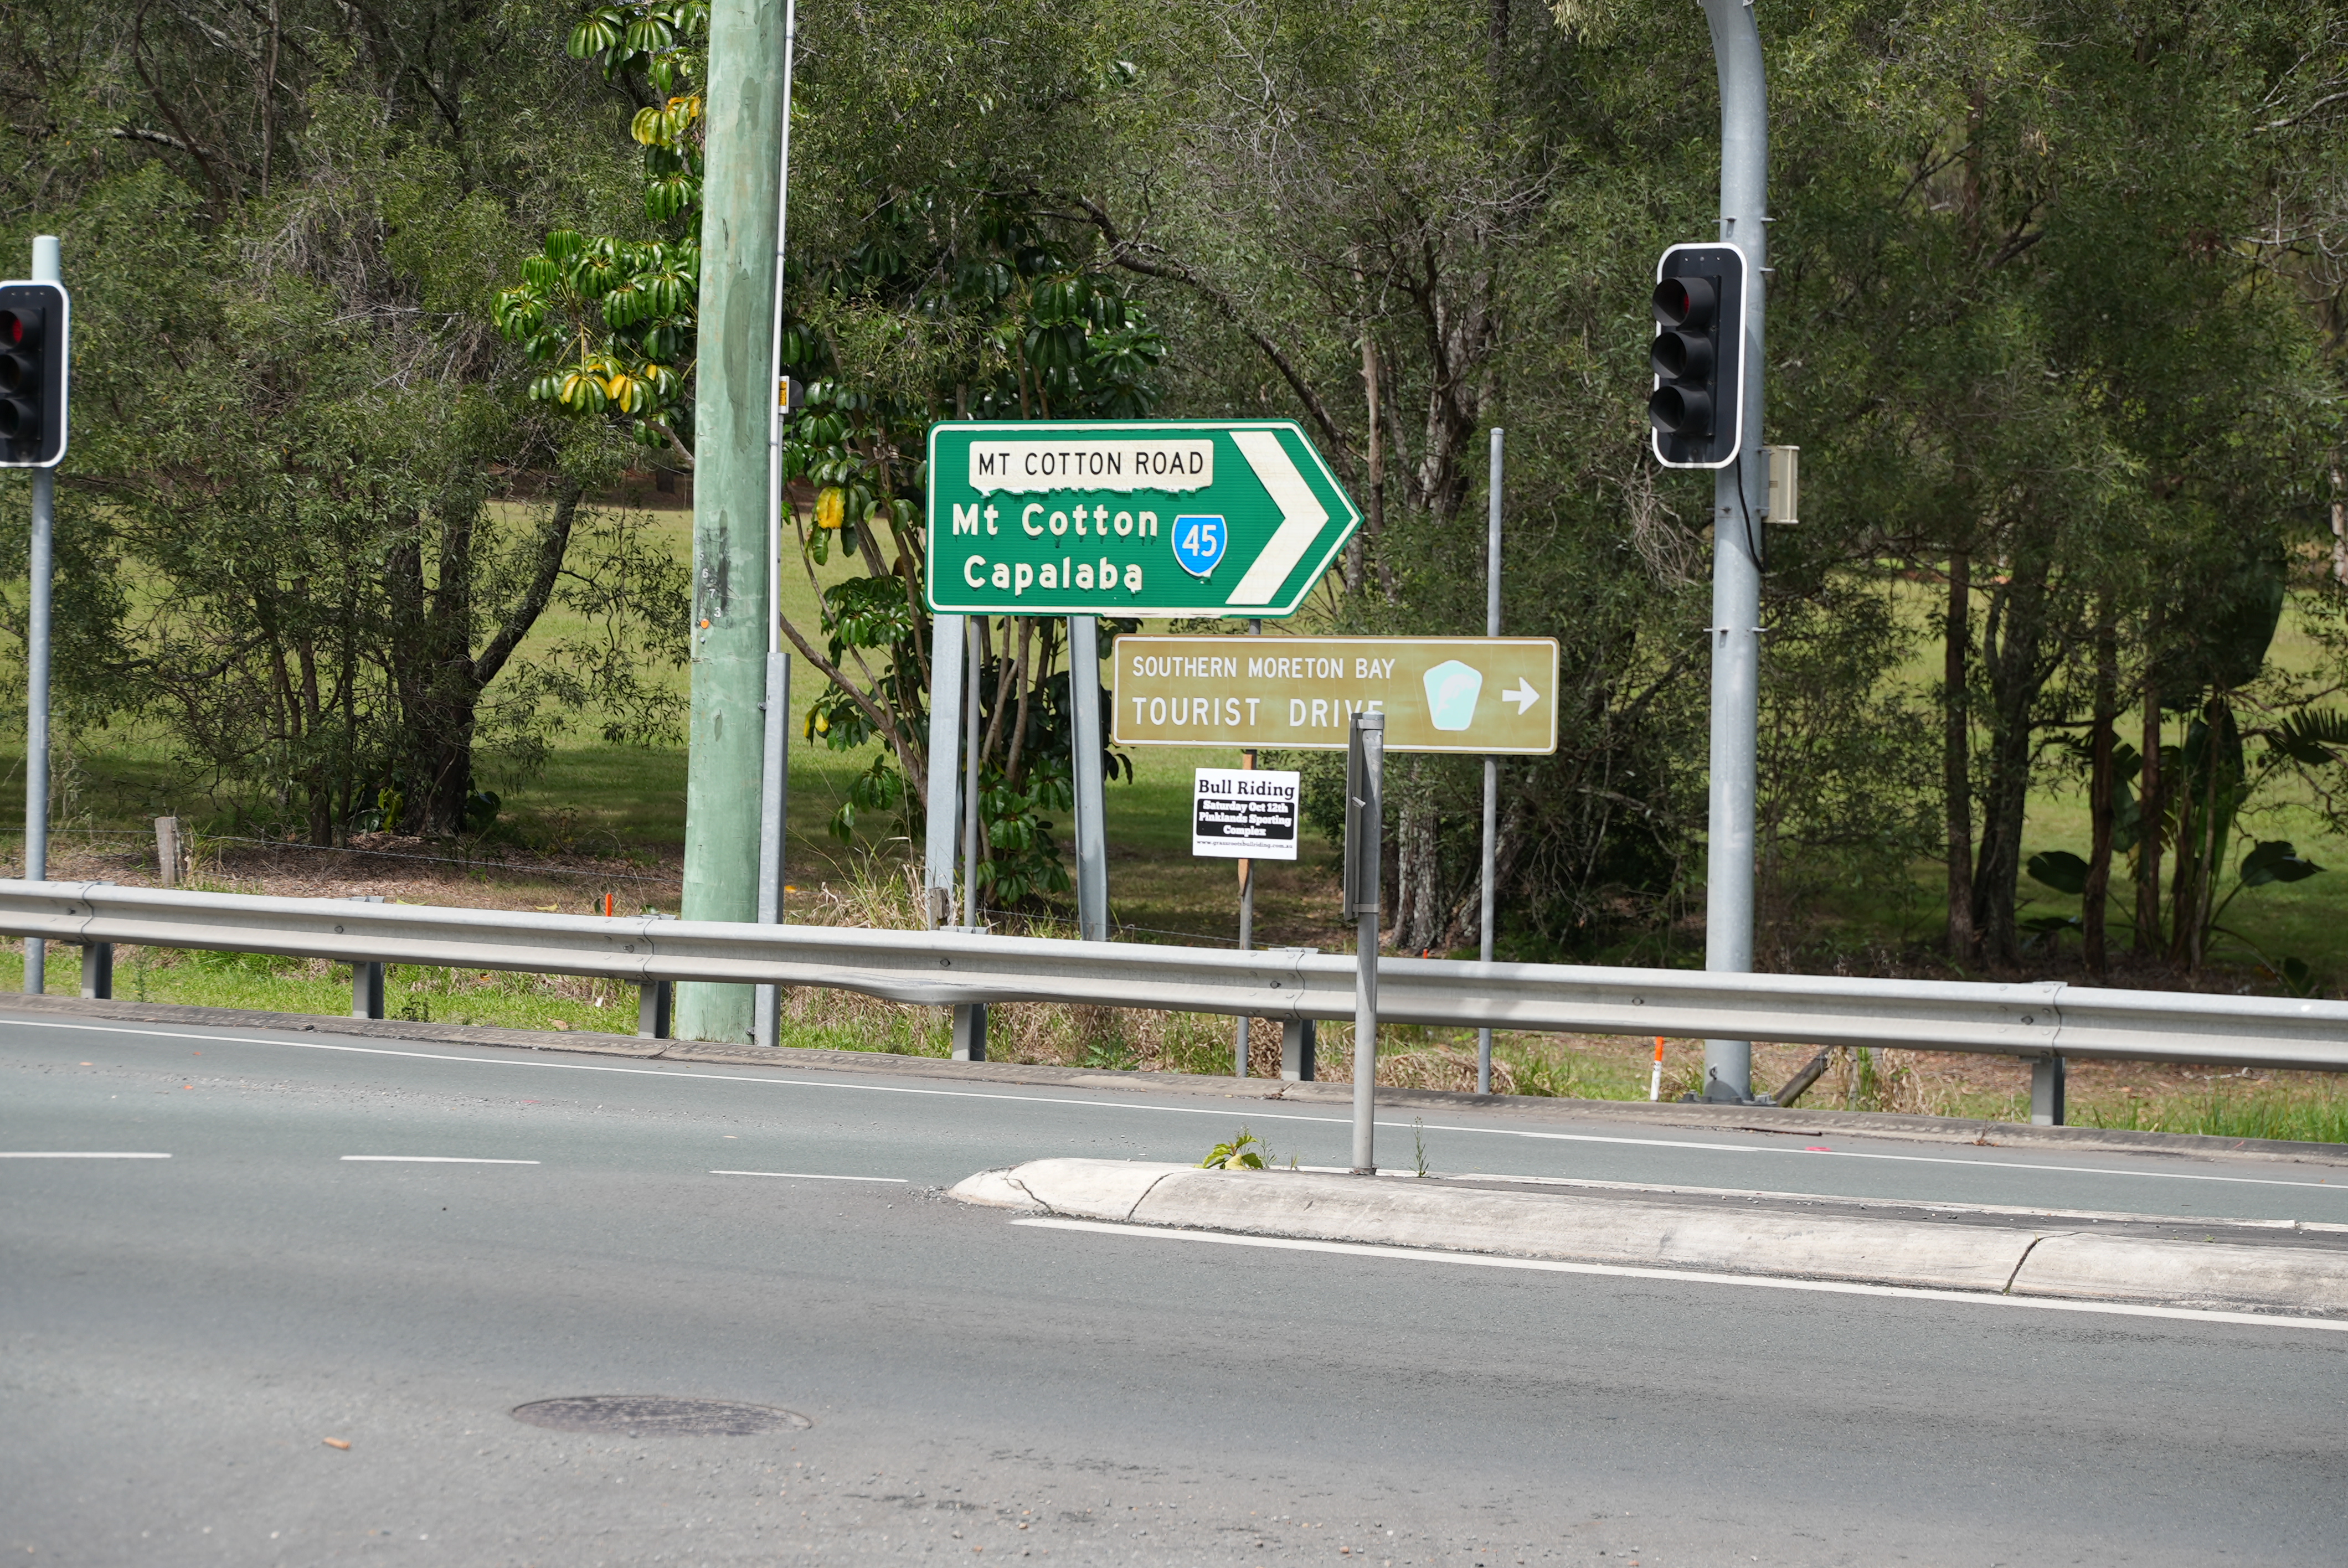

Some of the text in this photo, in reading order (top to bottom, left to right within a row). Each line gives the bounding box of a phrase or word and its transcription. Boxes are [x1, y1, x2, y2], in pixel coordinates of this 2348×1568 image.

[979, 451, 1203, 475] MT COTTON ROAD
[952, 503, 1158, 537] Mt Cotton
[1182, 524, 1218, 557] 45
[964, 554, 1142, 596] Capalaba
[1132, 656, 1396, 679] SOUTHERN MORETON BAY
[1132, 697, 1260, 726] TOURIST
[1199, 780, 1295, 800] Bull Riding
[1203, 800, 1289, 813] Saturday Oct 12th
[1199, 812, 1291, 827] Pinklands Sporting
[1223, 825, 1266, 837] Complex
